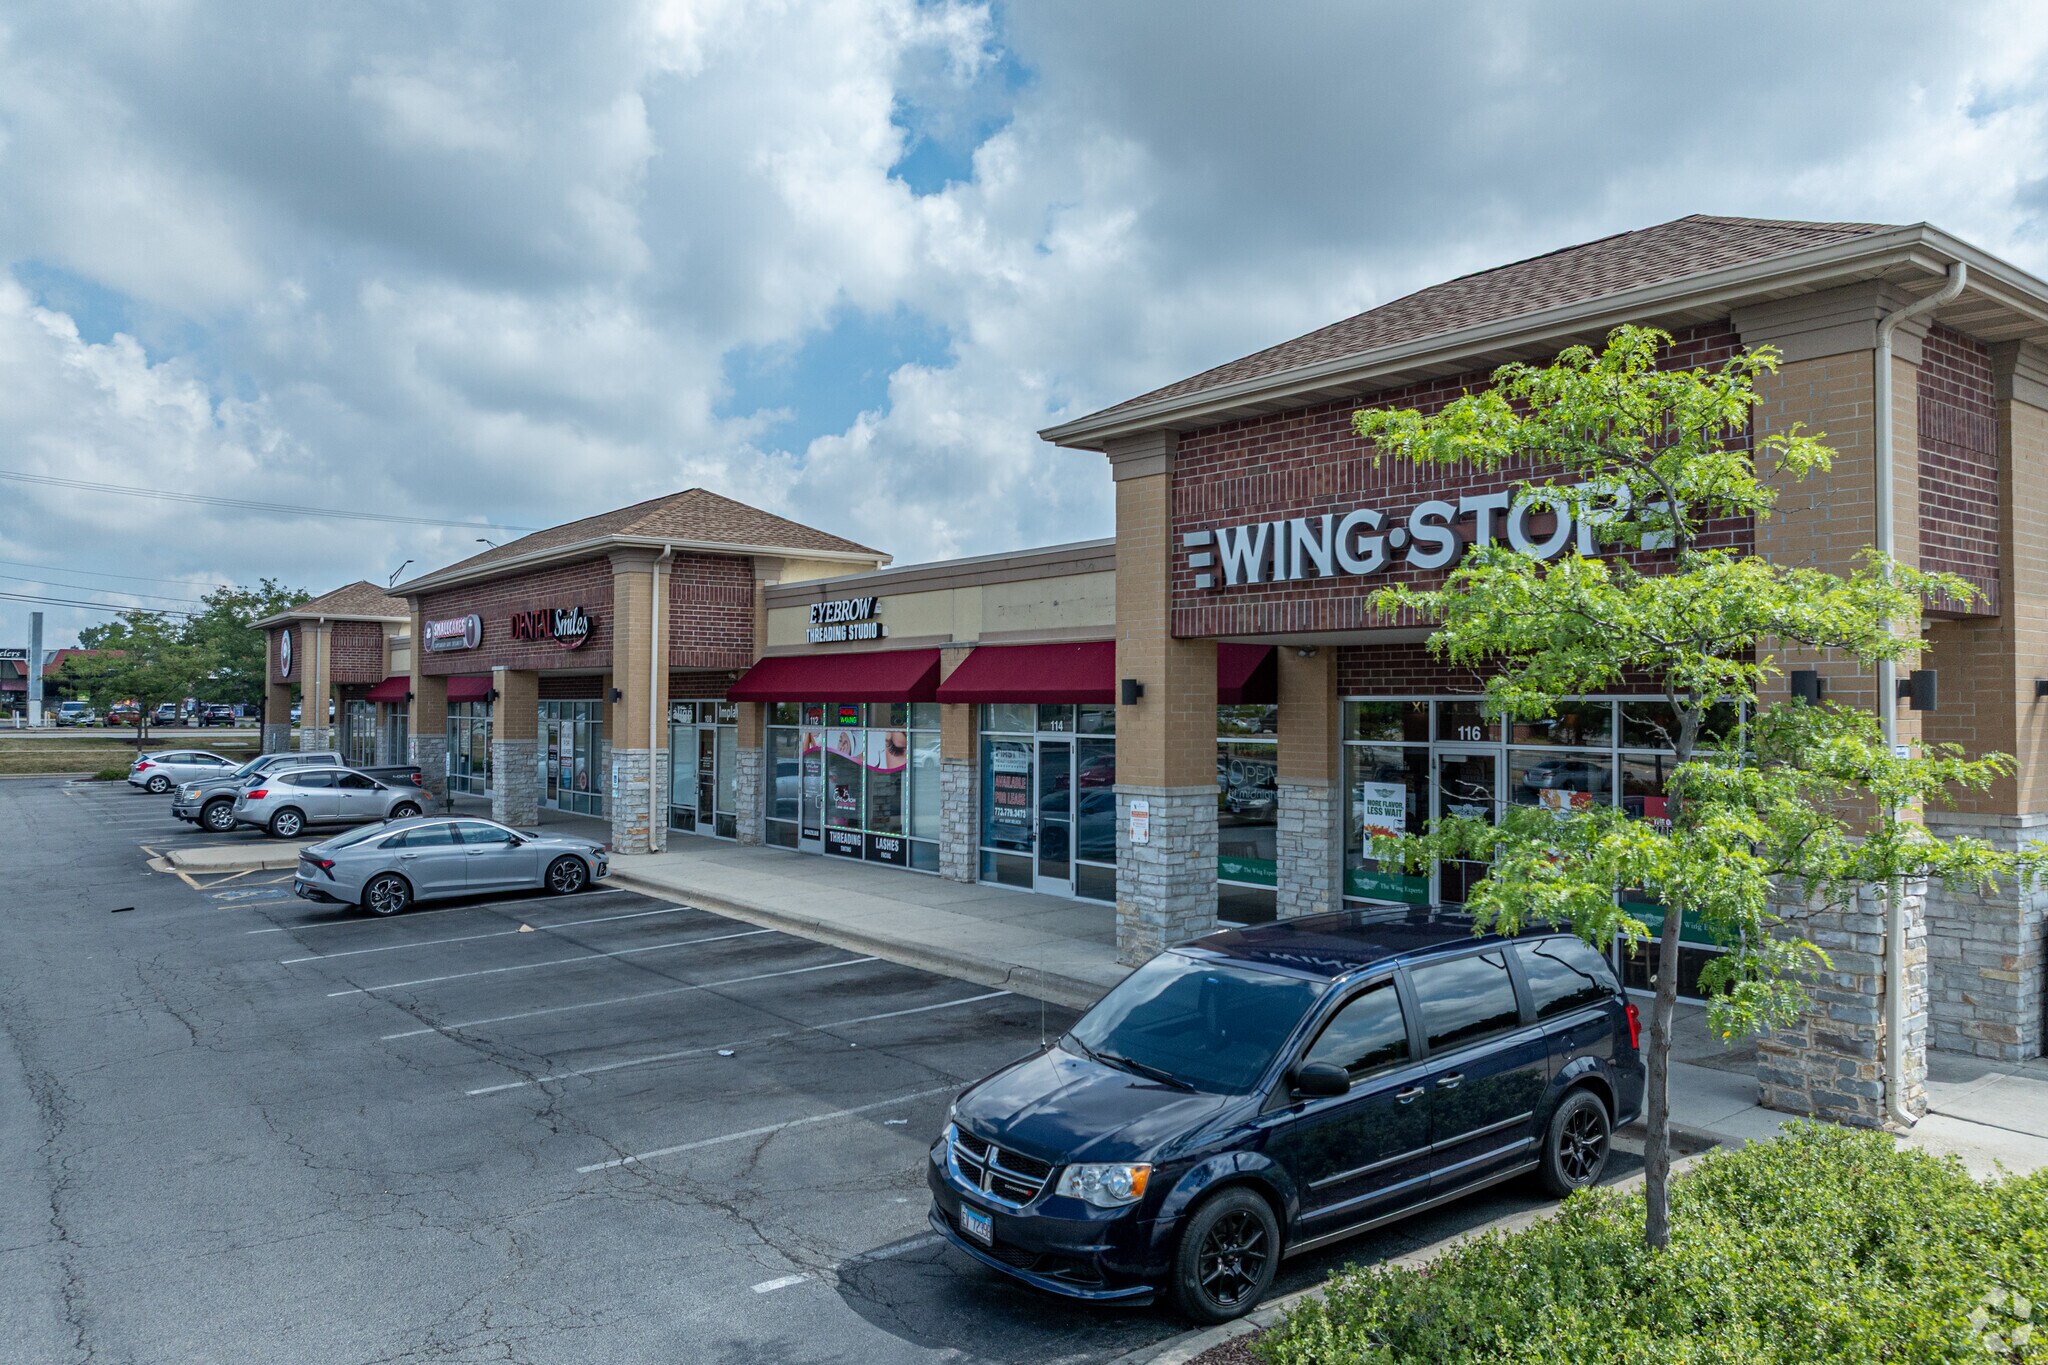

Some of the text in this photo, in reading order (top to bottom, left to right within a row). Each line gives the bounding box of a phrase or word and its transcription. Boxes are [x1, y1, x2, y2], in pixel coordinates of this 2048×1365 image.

[809, 597, 873, 624] EYEBROW
[434, 618, 465, 637] SMALLCAKES
[511, 606, 588, 640] DENTAL Smiles
[806, 622, 878, 643] THREADING STUDIO
[0, 649, 20, 657] elers
[810, 716, 819, 725] 112
[1050, 720, 1064, 731] 114
[1458, 726, 1481, 740] 116
[1239, 789, 1277, 802] midnigh
[1367, 807, 1402, 817] LESS WAIT
[830, 831, 861, 846] THREADING
[875, 837, 899, 852] LASHES
[1380, 883, 1423, 895] The Wing Experts
